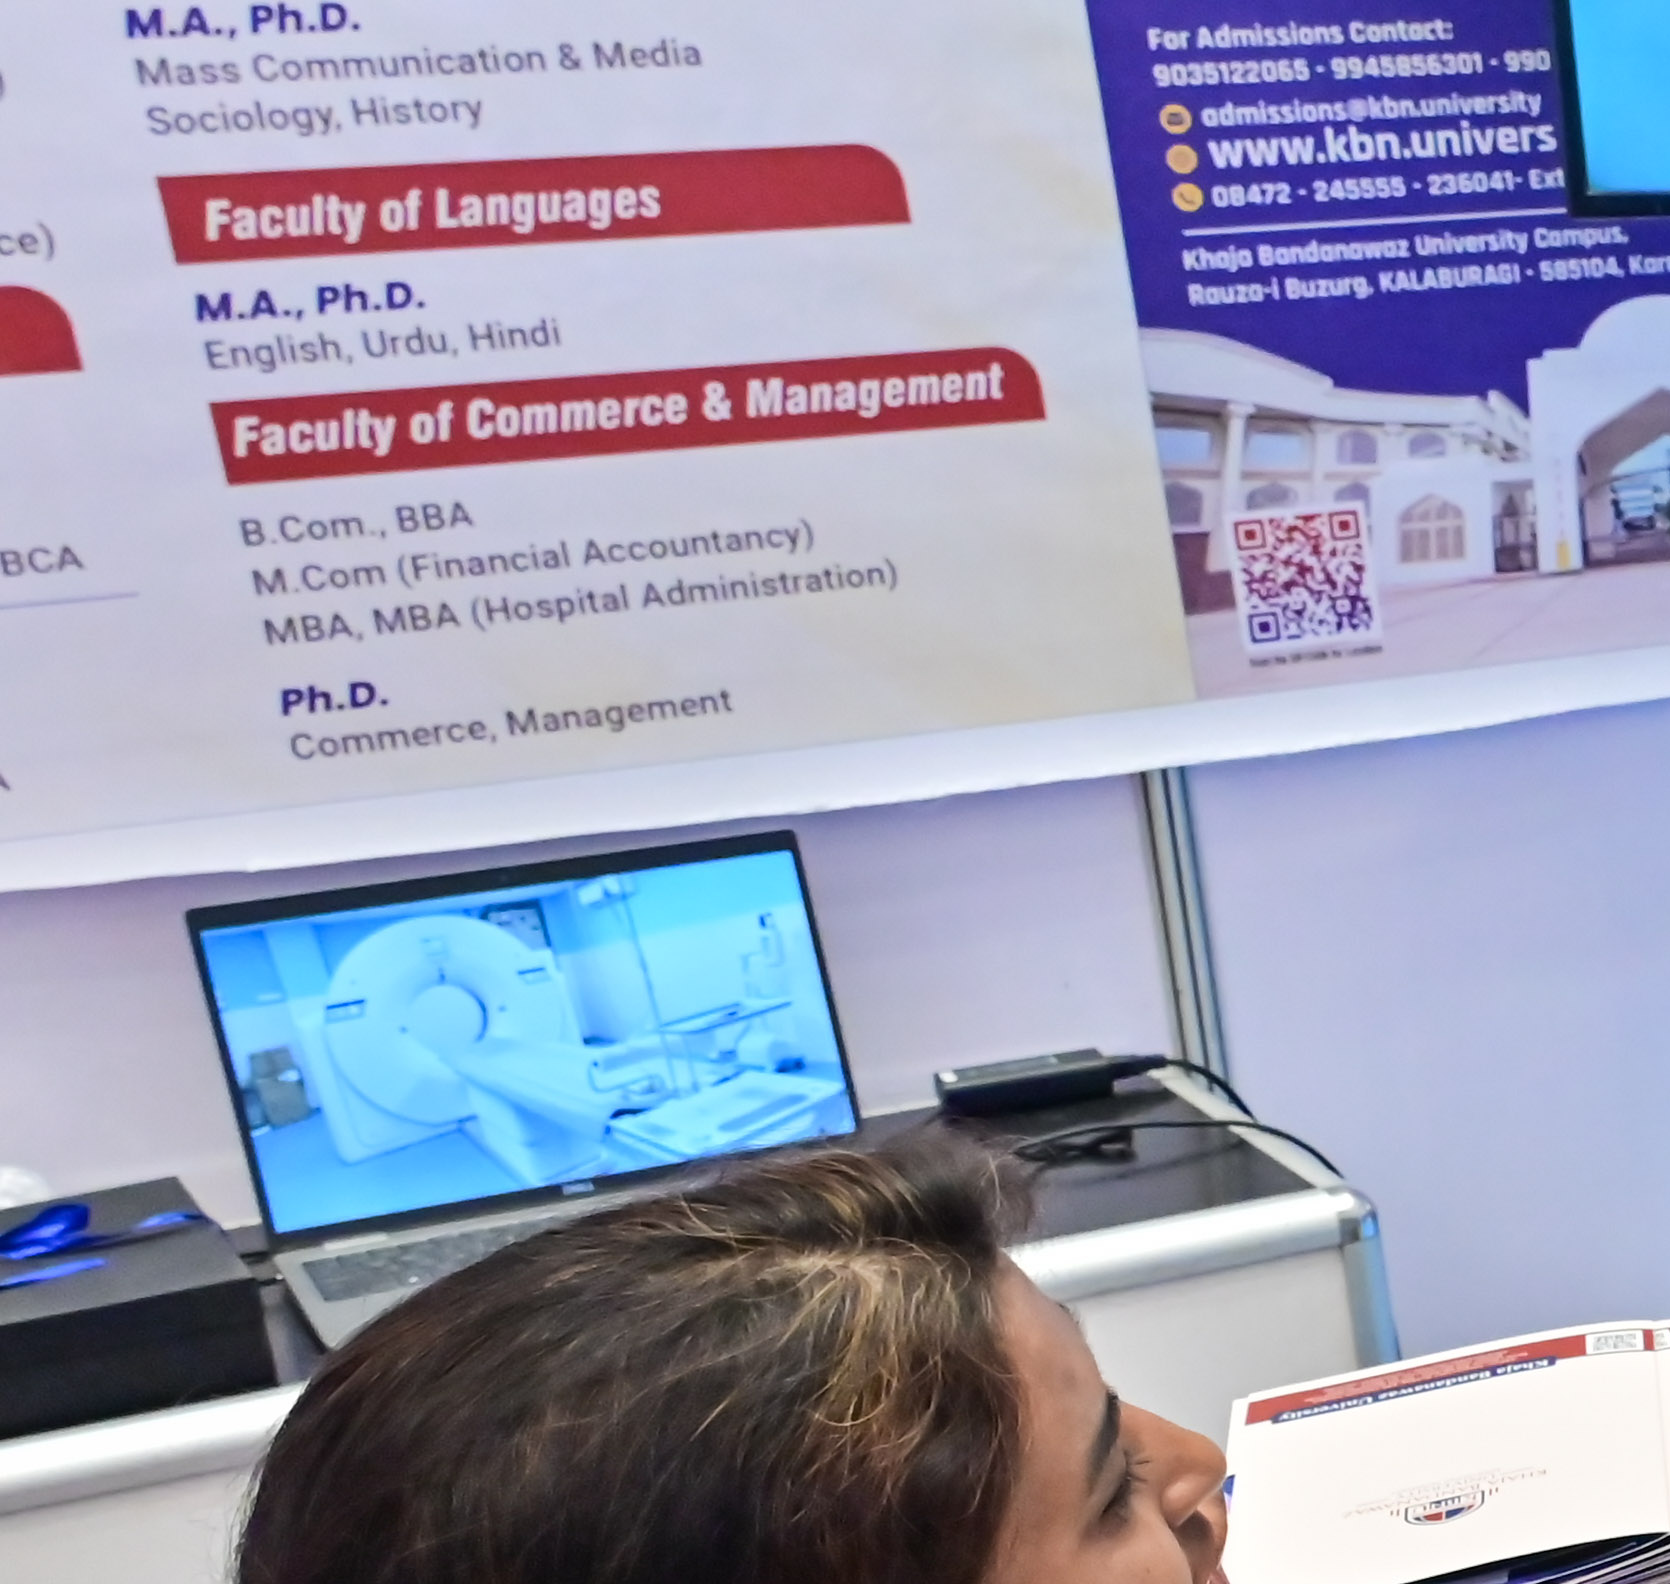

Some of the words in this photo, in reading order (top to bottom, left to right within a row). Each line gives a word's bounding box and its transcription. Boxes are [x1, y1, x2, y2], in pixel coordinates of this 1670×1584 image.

[124, 6, 236, 39] M.A.,
[249, 1, 360, 34] Ph.D.
[1145, 26, 1190, 51] For
[1195, 20, 1345, 49] Admissions
[1347, 18, 1454, 44] Contact:
[133, 56, 241, 86] Mass
[251, 44, 547, 83] Communication
[556, 41, 582, 71] &
[590, 37, 702, 69] Media
[145, 99, 342, 137] Sociology,
[348, 96, 482, 130] History
[204, 192, 367, 244] Faculty
[378, 187, 423, 232] of
[434, 184, 661, 234] Languages
[1210, 180, 1292, 208] 08472
[1181, 243, 1254, 273] Khaja
[1255, 238, 1411, 267] Bandanawaz
[1413, 228, 1529, 256] University
[1532, 225, 1629, 249] Campus,
[194, 288, 303, 322] M.A.,
[316, 280, 425, 315] Ph.D.
[202, 331, 353, 374] English,
[360, 325, 458, 359] Urdu,
[466, 317, 561, 351] Hindi
[232, 407, 397, 458] Faculty
[408, 399, 454, 444] of
[465, 392, 688, 440] Commerce
[700, 379, 732, 422] &
[745, 361, 1004, 419] Management
[237, 511, 385, 548] B.Com.,
[395, 500, 473, 535] BBA
[0, 544, 84, 577] BCA
[250, 563, 387, 596] M.Com
[396, 539, 571, 588] (Financial
[582, 518, 814, 566] Accountancy)
[262, 611, 364, 646] MBA,
[371, 601, 461, 635] MBA
[469, 582, 629, 632] (Hospital
[641, 557, 898, 609] Administration)
[280, 680, 388, 716] Ph.D.
[289, 719, 497, 761] Commerce,
[503, 688, 733, 736] Management
